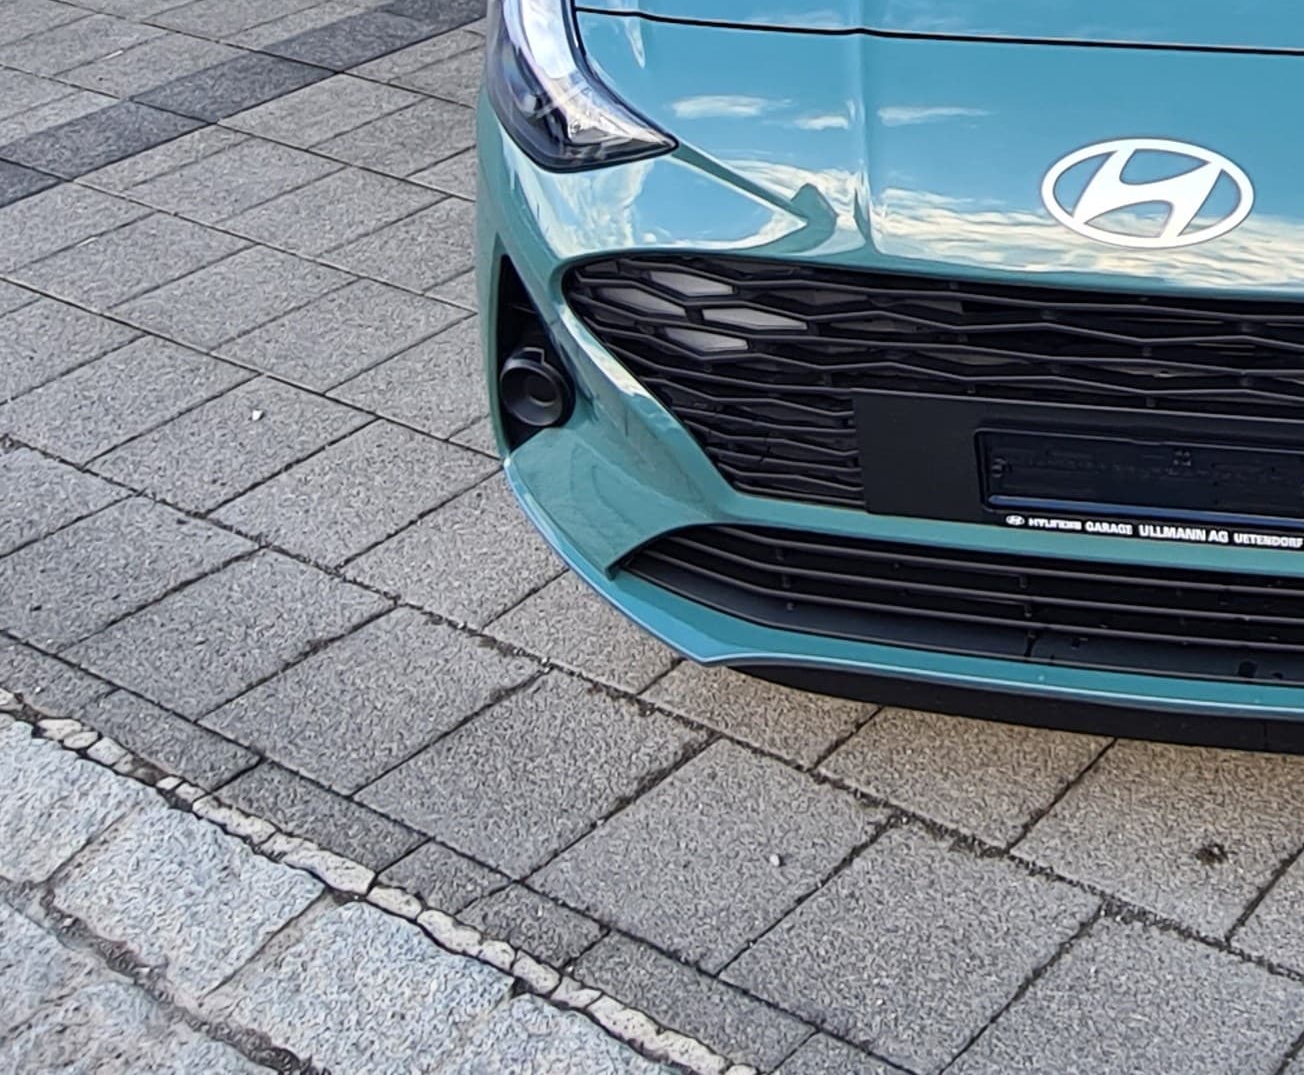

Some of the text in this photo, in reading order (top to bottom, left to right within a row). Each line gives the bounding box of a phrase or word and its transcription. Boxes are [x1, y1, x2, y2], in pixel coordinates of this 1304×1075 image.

[1085, 521, 1133, 535] GARAGE
[1138, 524, 1207, 542] ULLMANN
[1207, 529, 1229, 544] AG
